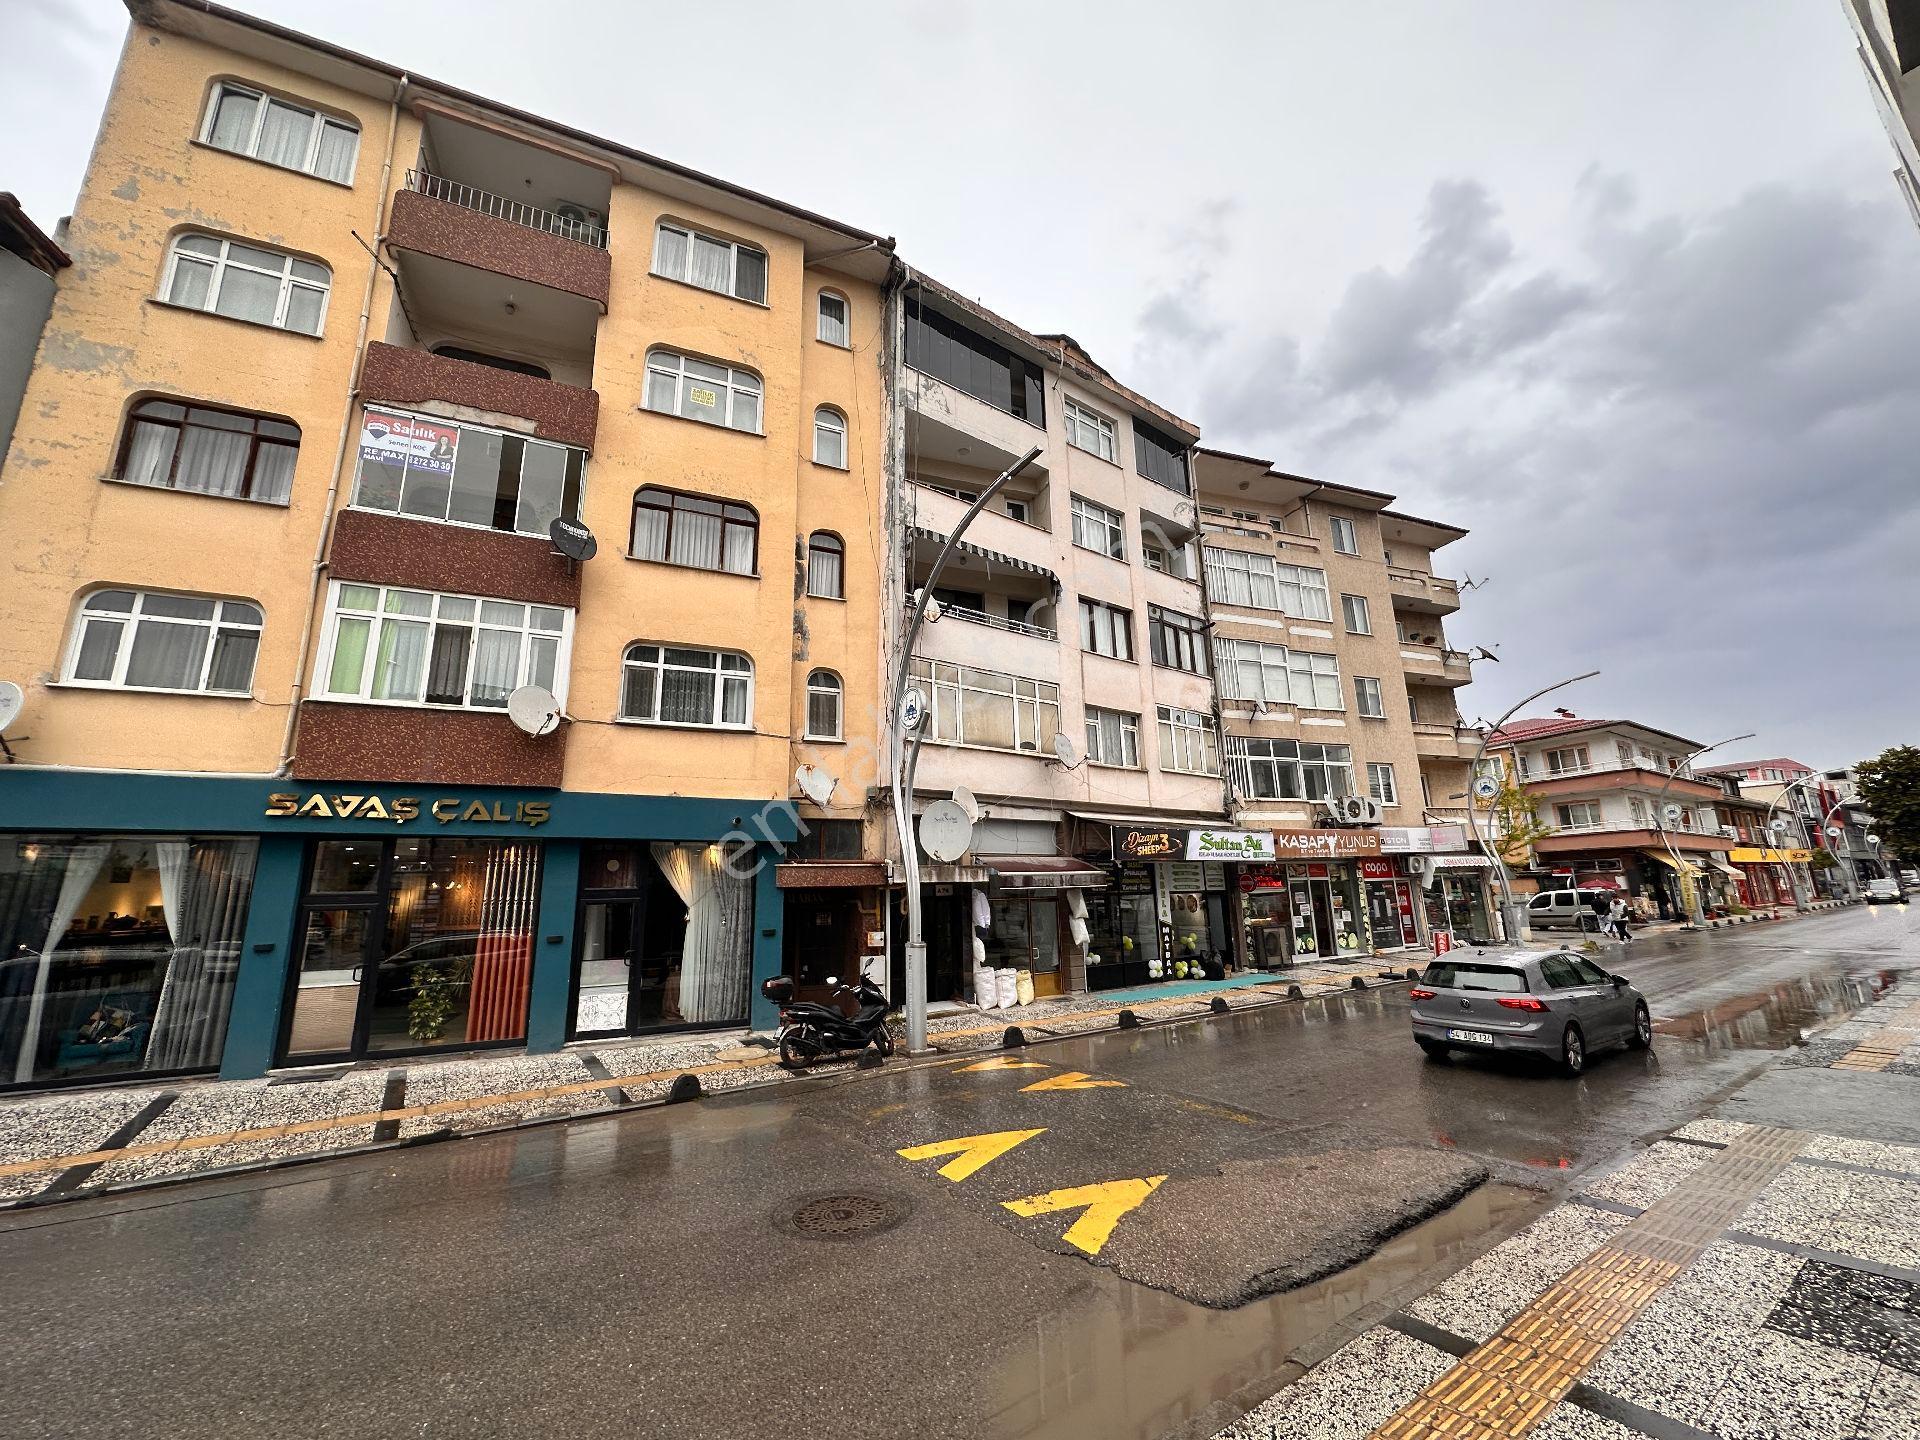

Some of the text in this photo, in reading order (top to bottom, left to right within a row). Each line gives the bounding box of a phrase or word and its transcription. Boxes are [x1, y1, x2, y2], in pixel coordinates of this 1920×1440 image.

[429, 459, 439, 468] 30
[441, 461, 450, 470] 30
[265, 793, 420, 824] SAVAŞ
[1128, 832, 1159, 848] Dizayn
[1199, 832, 1242, 851] Sultan
[1279, 834, 1376, 848] KASAP YUNUS
[1137, 844, 1160, 855] SHEEP
[1162, 926, 1172, 975] MATBAA
[1438, 933, 1447, 954] KASA
